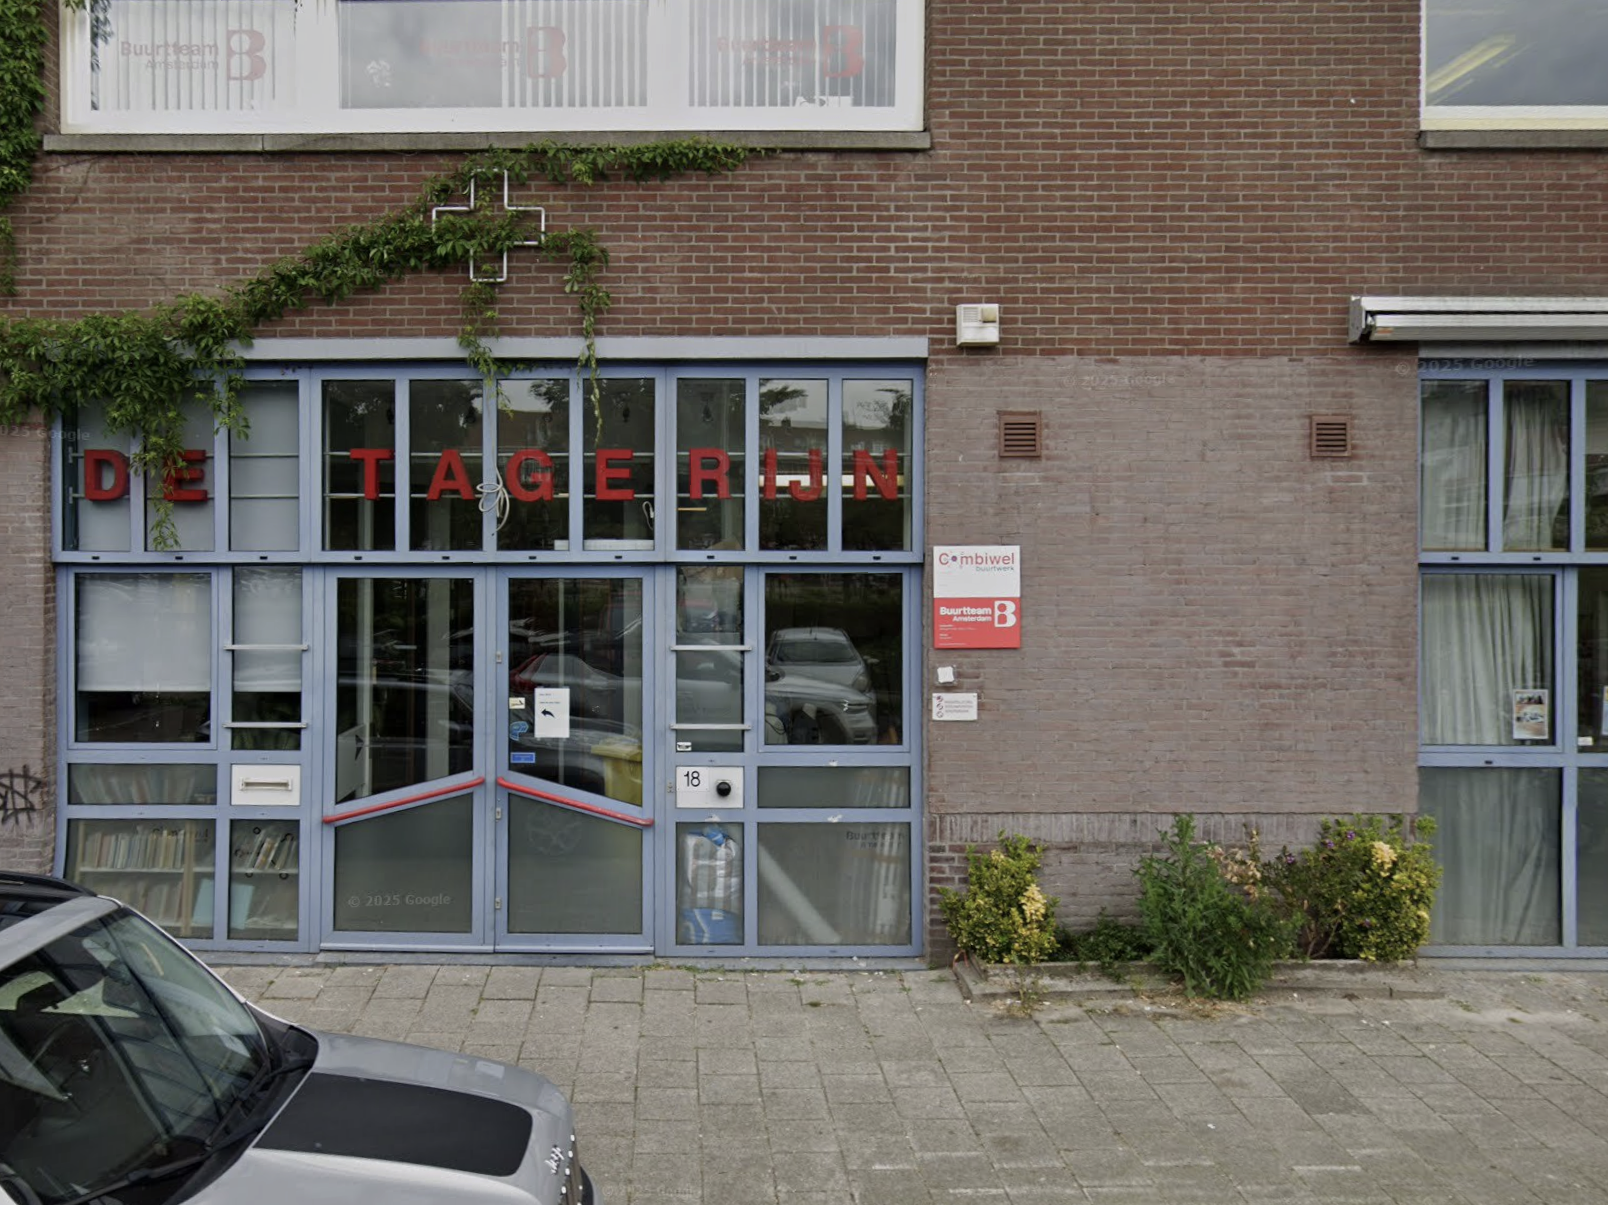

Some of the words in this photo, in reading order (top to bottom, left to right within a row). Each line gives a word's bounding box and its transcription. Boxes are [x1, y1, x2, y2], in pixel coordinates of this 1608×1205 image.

[120, 41, 219, 56] Buurtteam
[84, 449, 208, 501] DE
[349, 448, 898, 501] TAGERIJN
[939, 606, 992, 616] Buurtteam
[683, 770, 701, 788] 18
